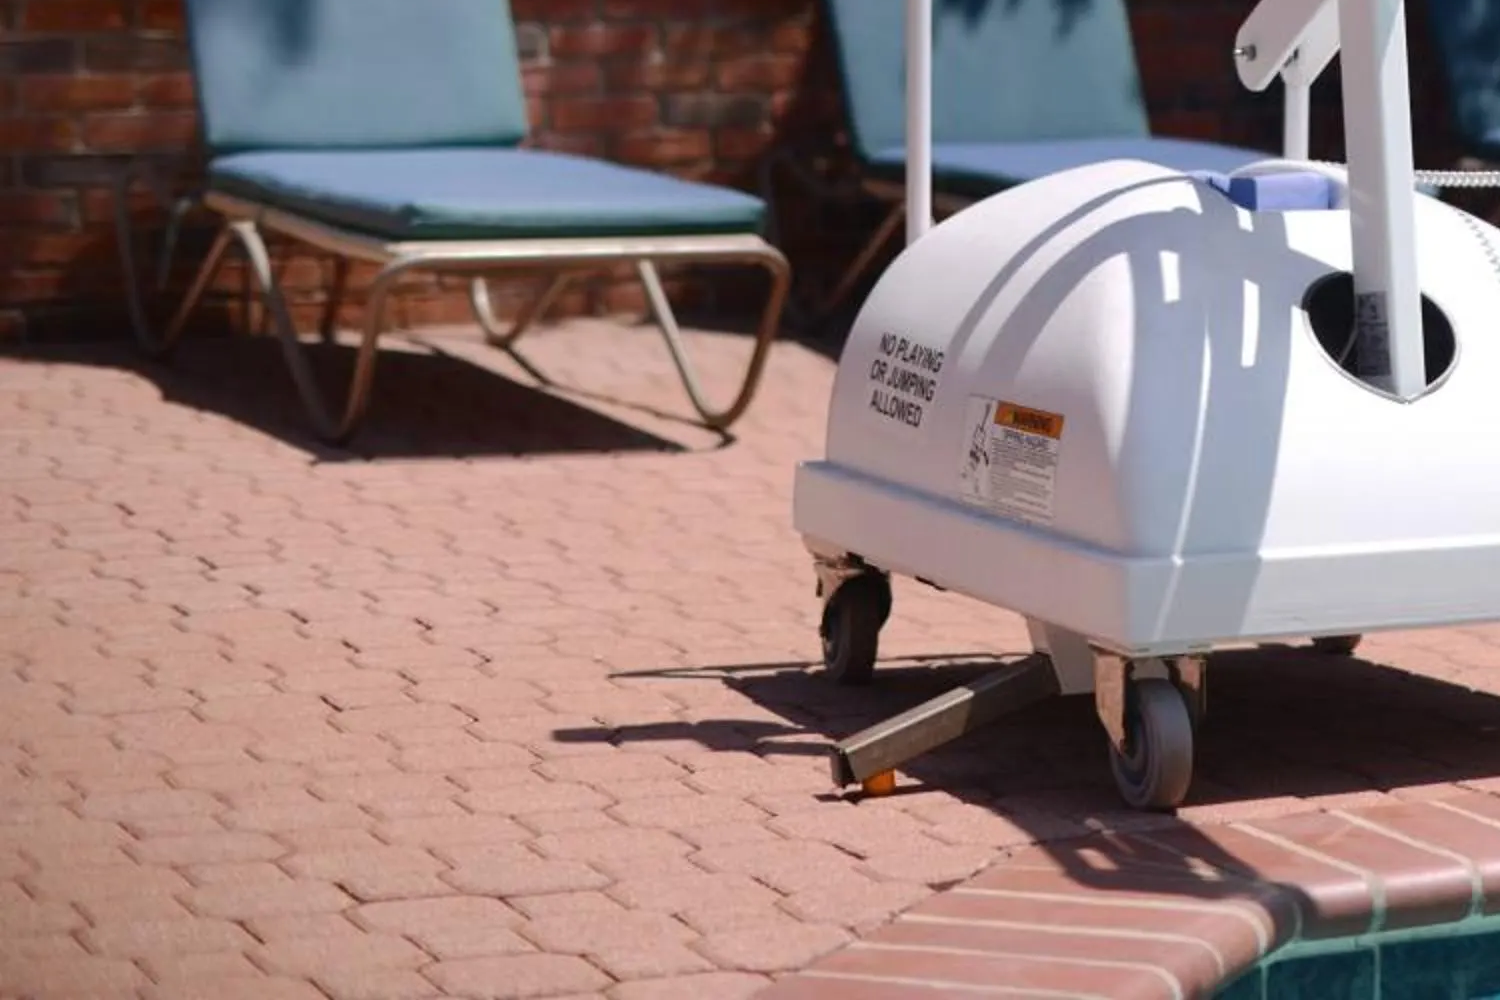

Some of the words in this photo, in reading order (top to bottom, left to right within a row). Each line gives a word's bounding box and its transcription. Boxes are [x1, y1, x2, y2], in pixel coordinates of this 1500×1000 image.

[879, 332, 897, 356] NO
[895, 337, 944, 373] PLAYING
[871, 359, 888, 384] OR
[886, 366, 937, 402] JUMPING
[870, 389, 922, 428] ALLOWED
